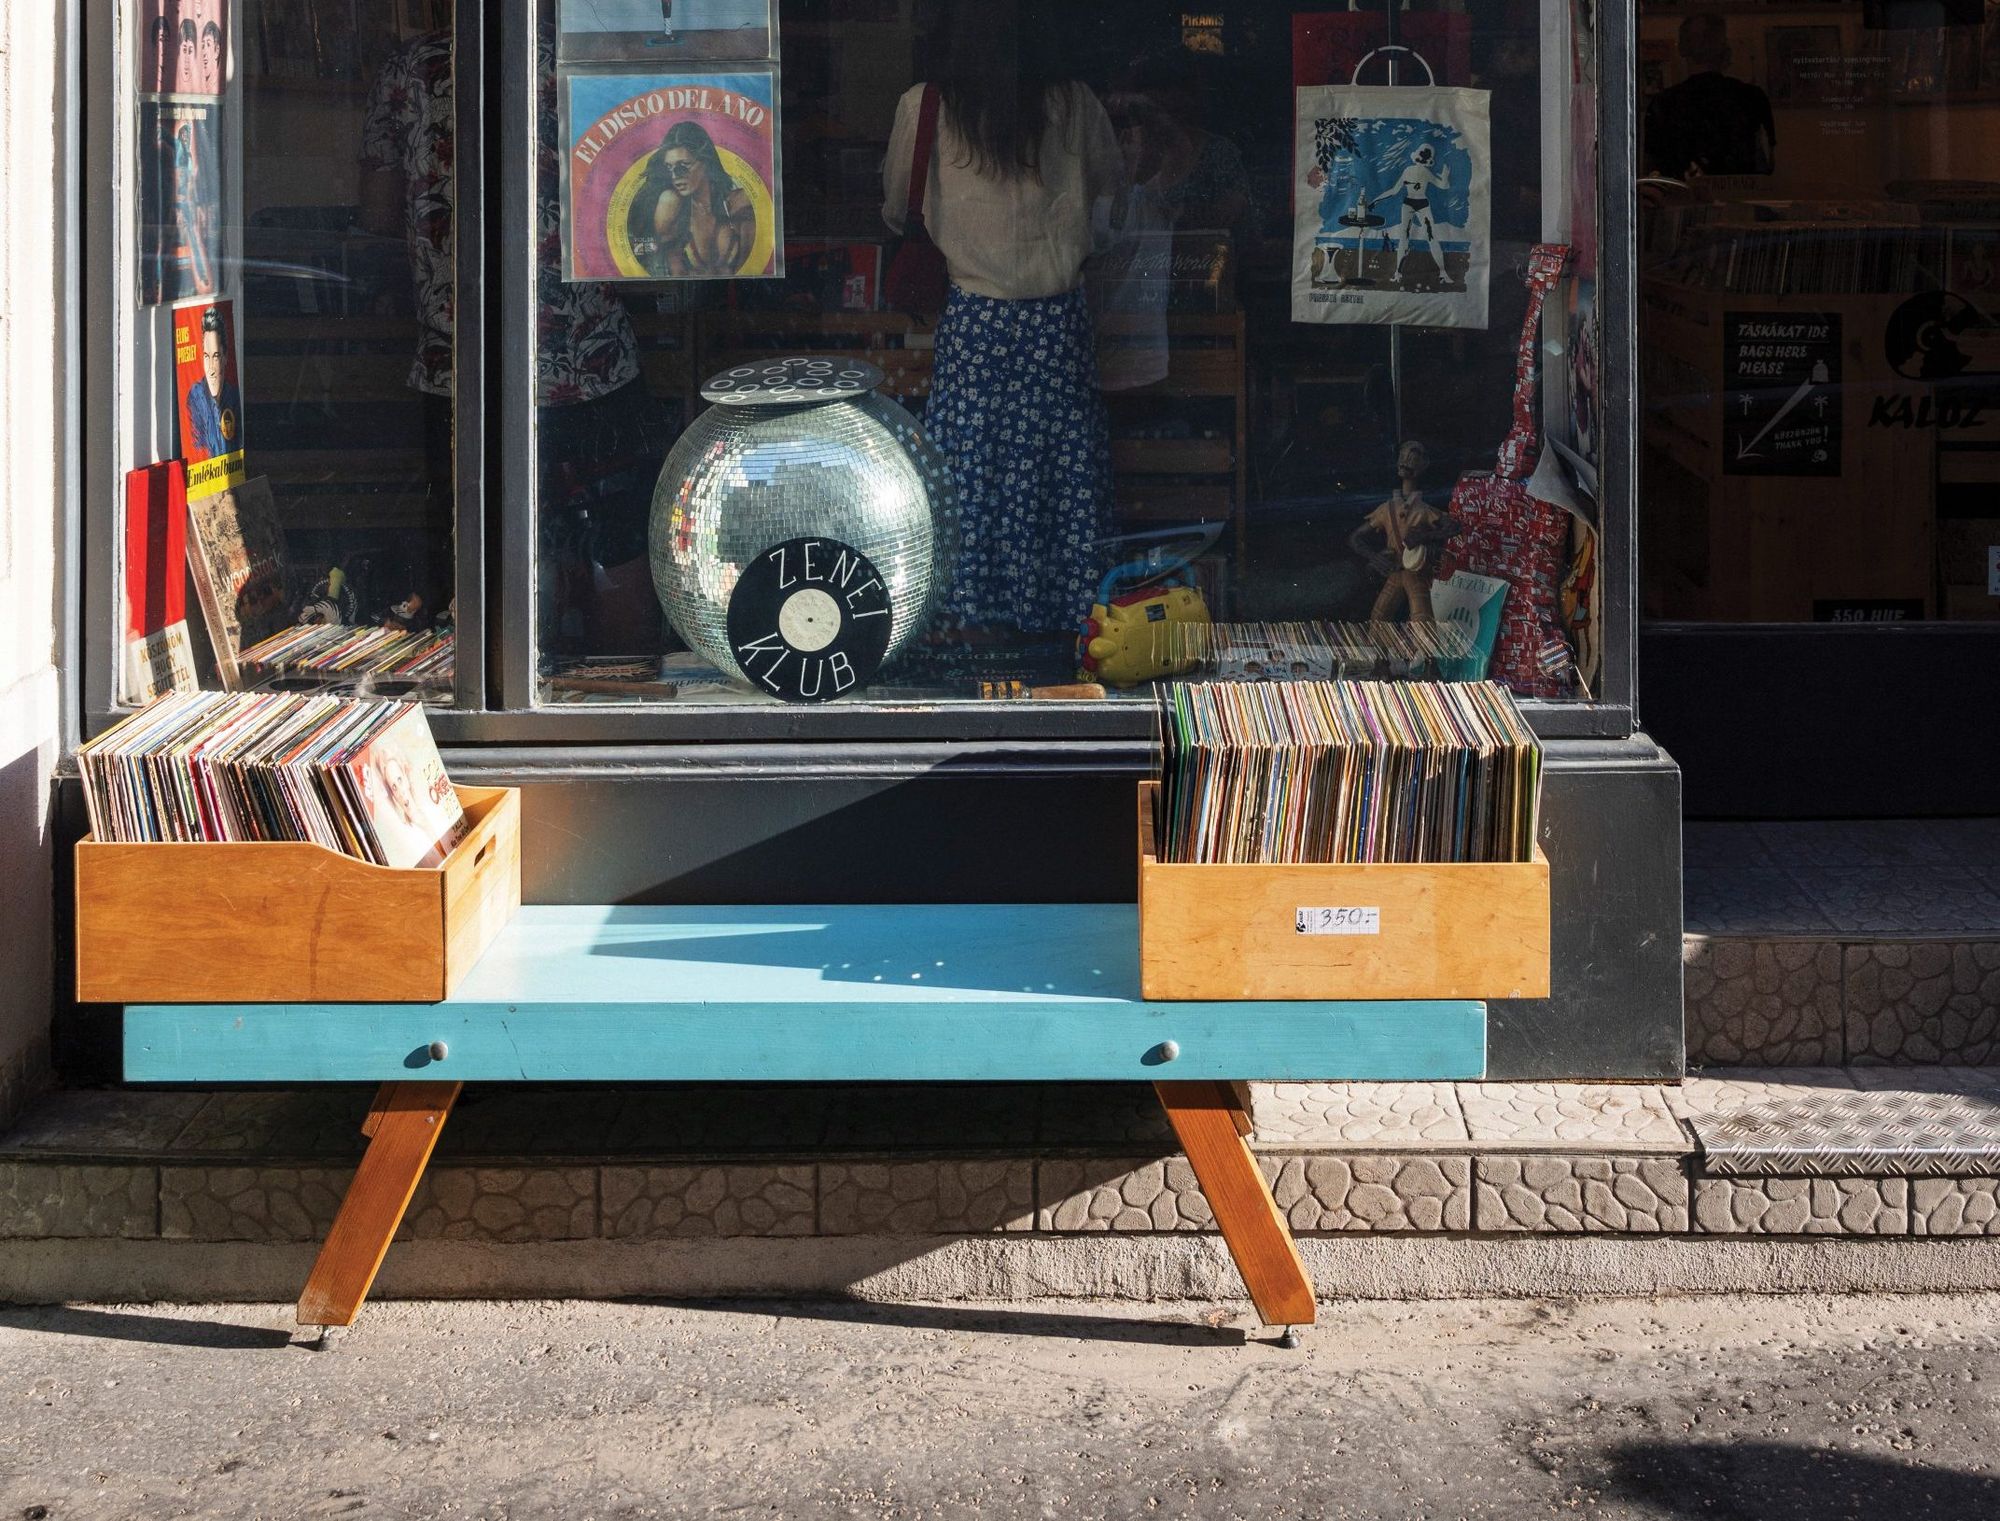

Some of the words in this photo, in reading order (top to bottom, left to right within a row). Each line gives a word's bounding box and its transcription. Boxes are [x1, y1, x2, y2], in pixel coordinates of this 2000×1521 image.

[1182, 14, 1224, 26] PIRAMIS
[575, 136, 605, 165] EL
[598, 93, 665, 140] DISCO
[668, 88, 713, 110] DEL
[717, 94, 765, 127] AÑO
[176, 326, 190, 345] ELVIS
[1738, 320, 1806, 338] TÁSKÁKAT
[1808, 323, 1830, 339] IDE
[177, 344, 197, 365] PRESLEY
[1739, 344, 1775, 358] BAGS
[1775, 344, 1808, 359] HERE
[1738, 361, 1785, 375] PLEASE
[188, 458, 244, 488] Emlékalbum
[769, 541, 889, 620] ZENEI
[738, 632, 856, 697] KLUB
